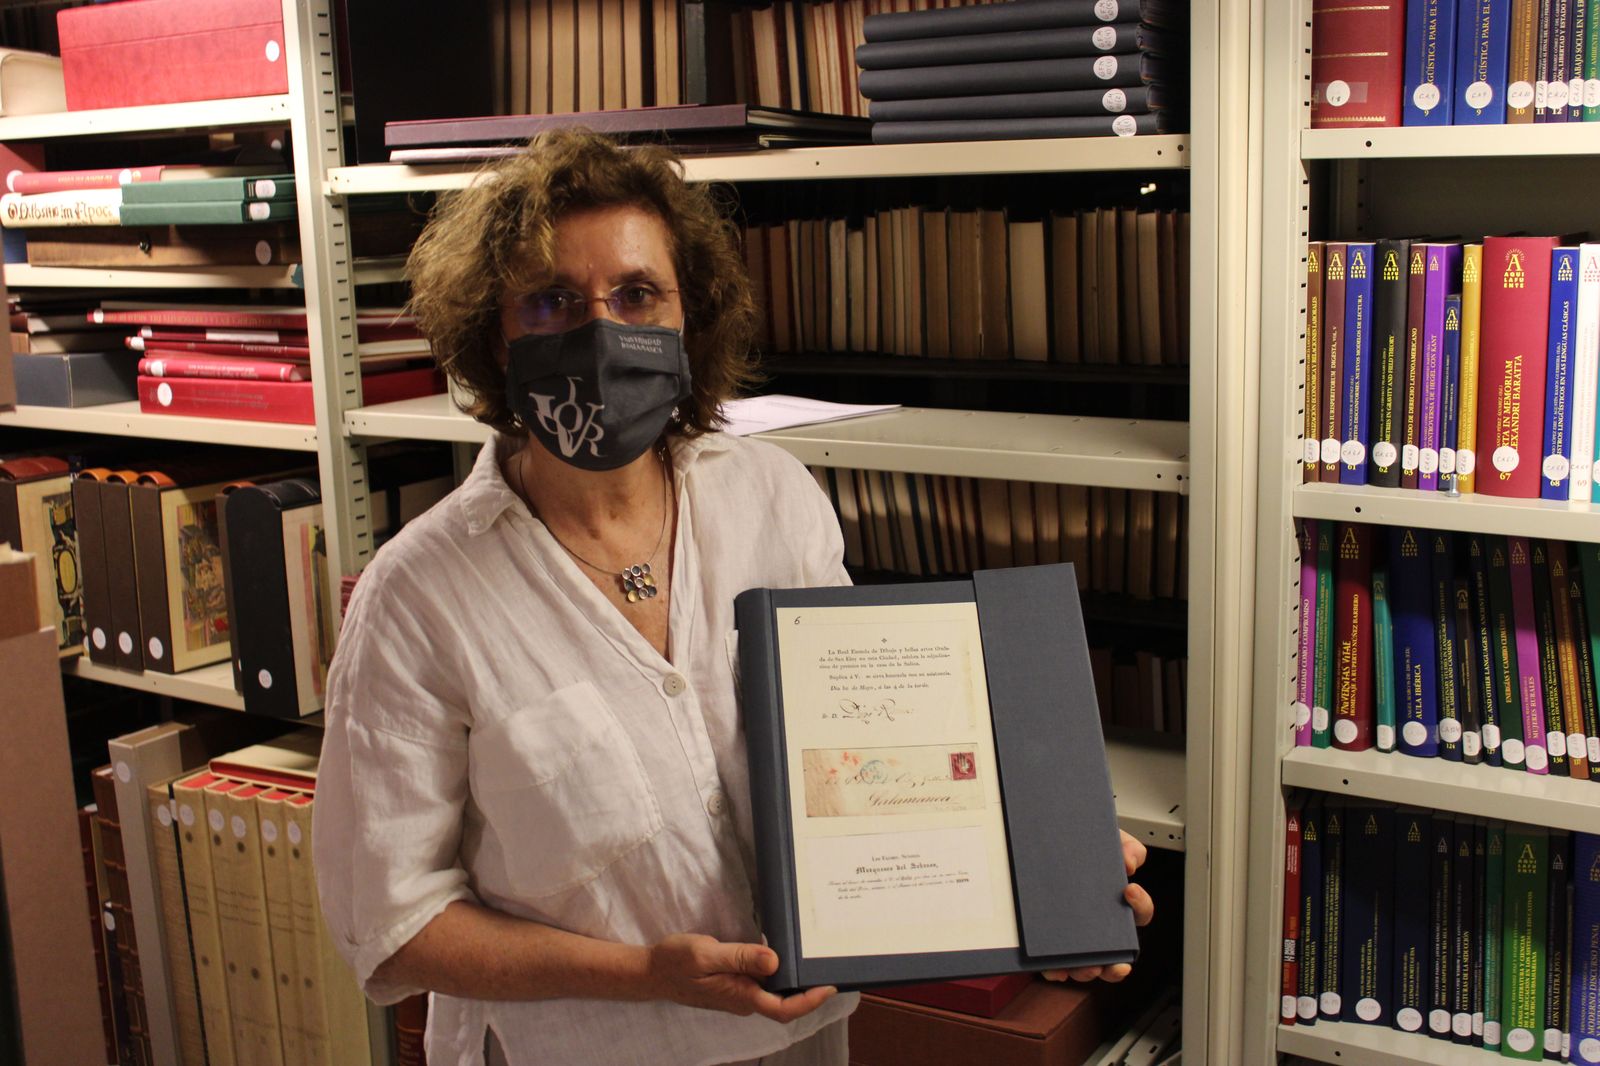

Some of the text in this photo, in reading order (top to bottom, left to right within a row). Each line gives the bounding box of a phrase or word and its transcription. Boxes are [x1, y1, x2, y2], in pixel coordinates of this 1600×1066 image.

[1430, 7, 1437, 16] EL
[1483, 4, 1490, 14] EL
[1577, 9, 1583, 17] LA
[1429, 19, 1437, 40] PARA
[1481, 17, 1490, 38] PARA
[1576, 19, 1583, 28] EN
[1575, 29, 1583, 53] SOCIAL
[1479, 41, 1488, 82] GÜÍSTICA
[1330, 254, 1342, 267] A
[1353, 252, 1365, 265] A
[1385, 253, 1396, 267] A
[1506, 254, 1523, 271] A
[1512, 355, 1522, 400] BARATTA
[1503, 360, 1513, 413] MEMORIAM
[1429, 391, 1435, 400] DE
[1557, 386, 1565, 431] LINGÜÍSTICOS
[1408, 414, 1414, 423] DE
[1502, 417, 1510, 427] IN
[794, 615, 802, 626] 6
[1482, 638, 1492, 675] LANGUAGES
[1413, 664, 1421, 696] IBÉRICA
[1484, 676, 1493, 697] OTHER
[1486, 698, 1494, 713] AND
[1528, 676, 1540, 739] MUJERES RURALES
[1462, 972, 1469, 980] DE
[1463, 964, 1469, 972] LA
[1553, 973, 1561, 994] LETRA
[1587, 924, 1599, 1035] MODERNO DISCURSO PENAL
